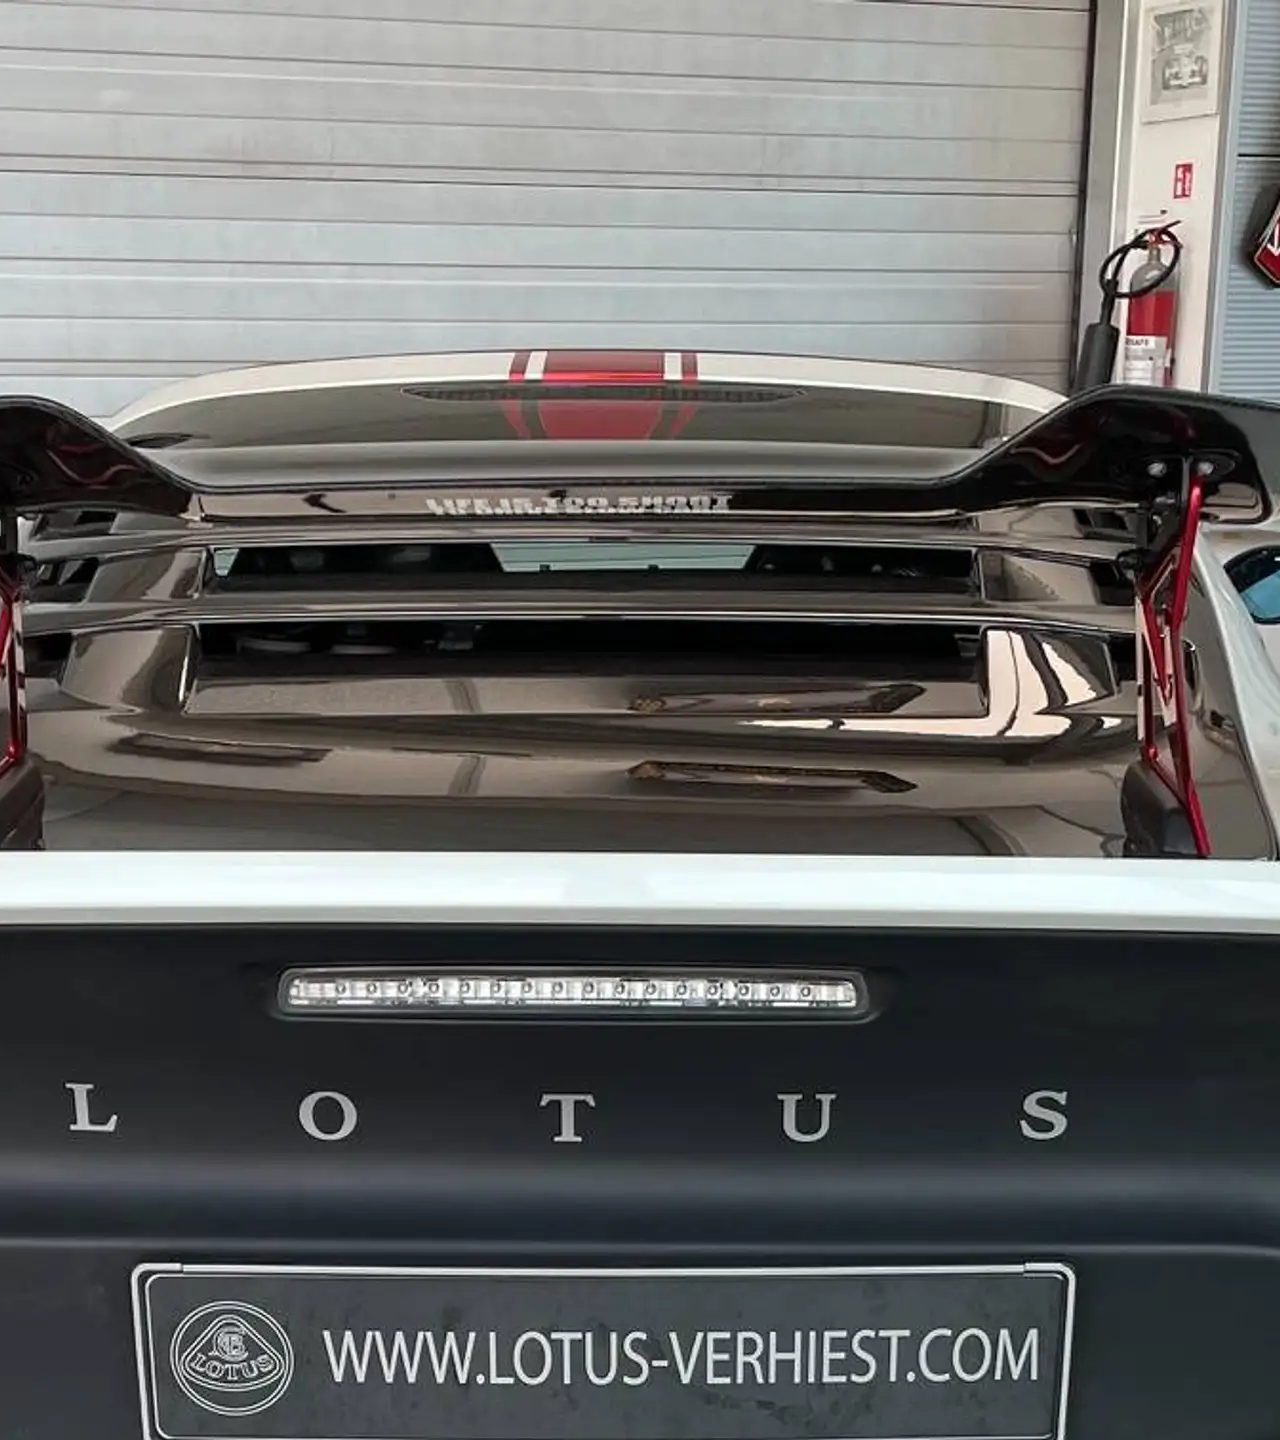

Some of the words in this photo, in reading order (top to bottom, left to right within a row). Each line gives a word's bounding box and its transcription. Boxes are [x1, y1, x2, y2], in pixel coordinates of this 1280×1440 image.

[65, 1082, 1069, 1143] LOTUS
[190, 1353, 275, 1380] LOTUS
[322, 1328, 1039, 1386] WWW.LOTUS-VERHIEST.COM
